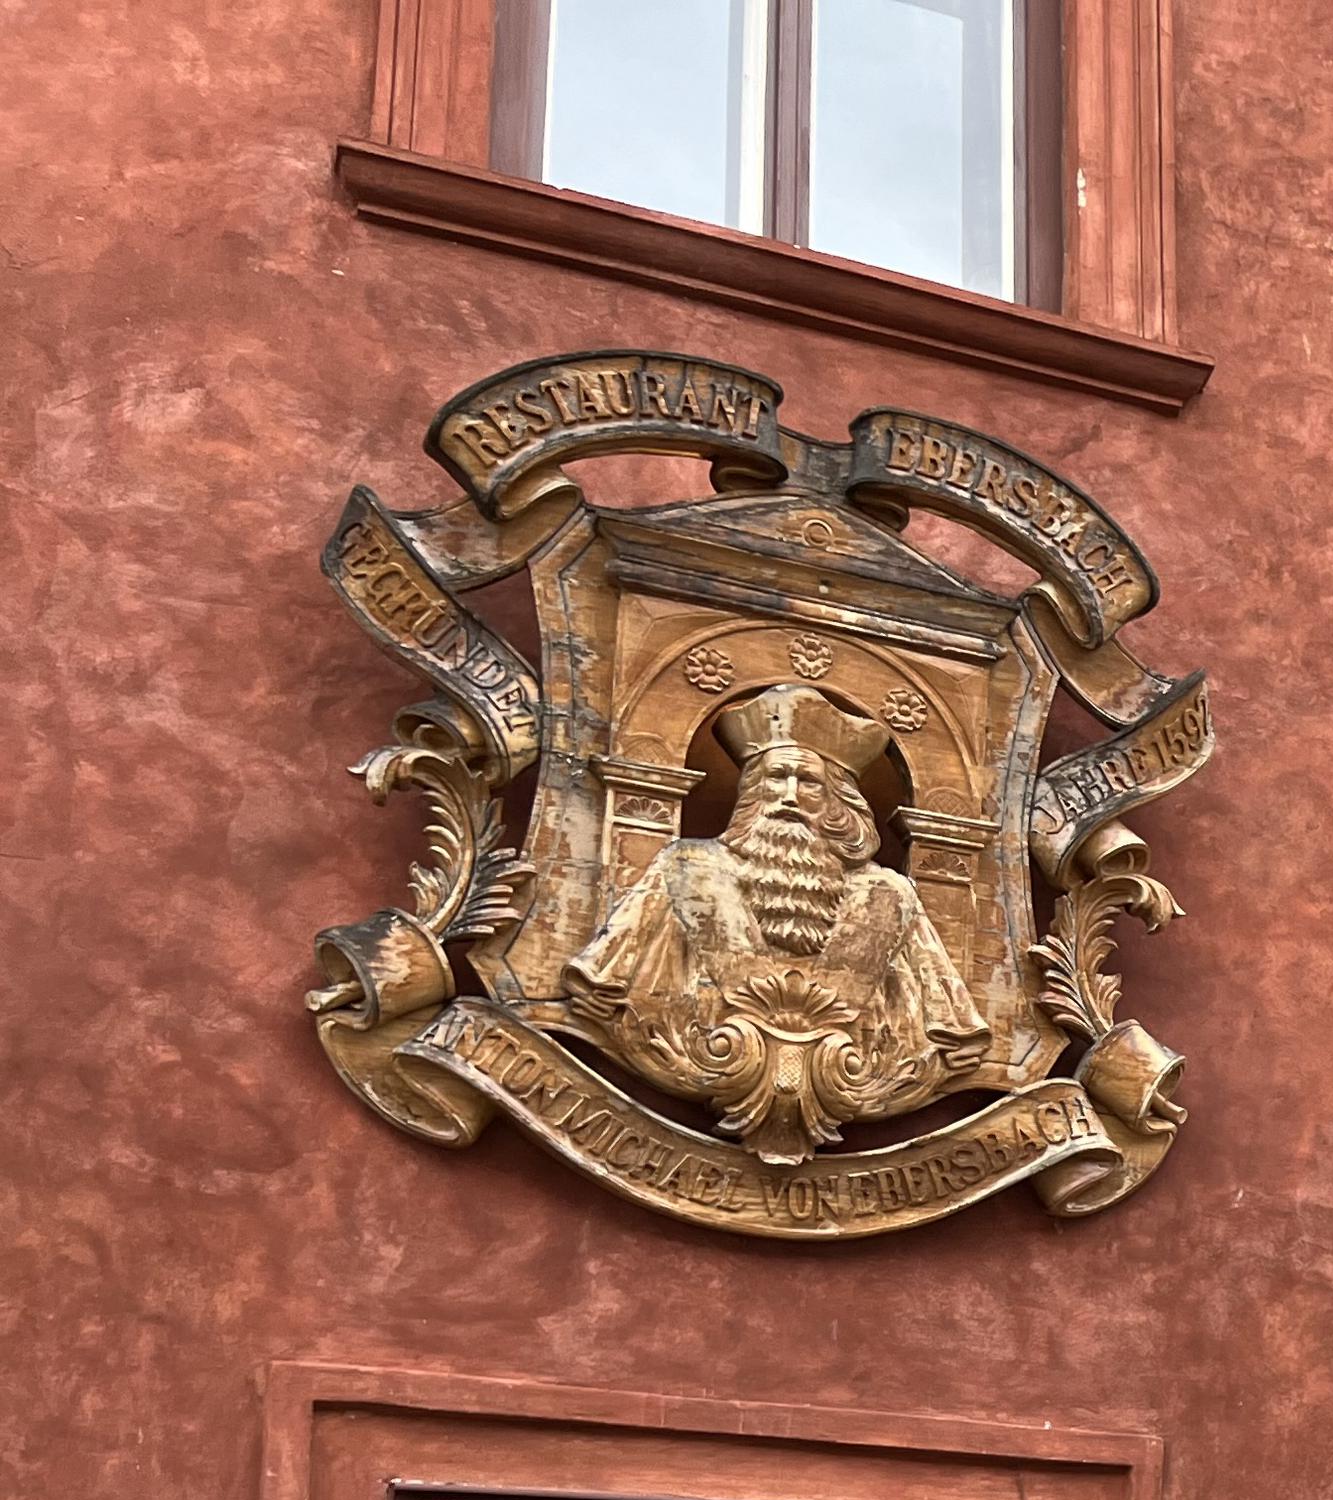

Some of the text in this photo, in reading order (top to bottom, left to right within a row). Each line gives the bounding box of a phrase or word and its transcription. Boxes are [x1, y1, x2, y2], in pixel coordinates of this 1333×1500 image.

[452, 369, 1134, 598] RESTAURANT EBERSBACH
[1029, 748, 1149, 835] JAHRE
[415, 1015, 1098, 1220] ANTON MICHAEL VON EBERSBACH
